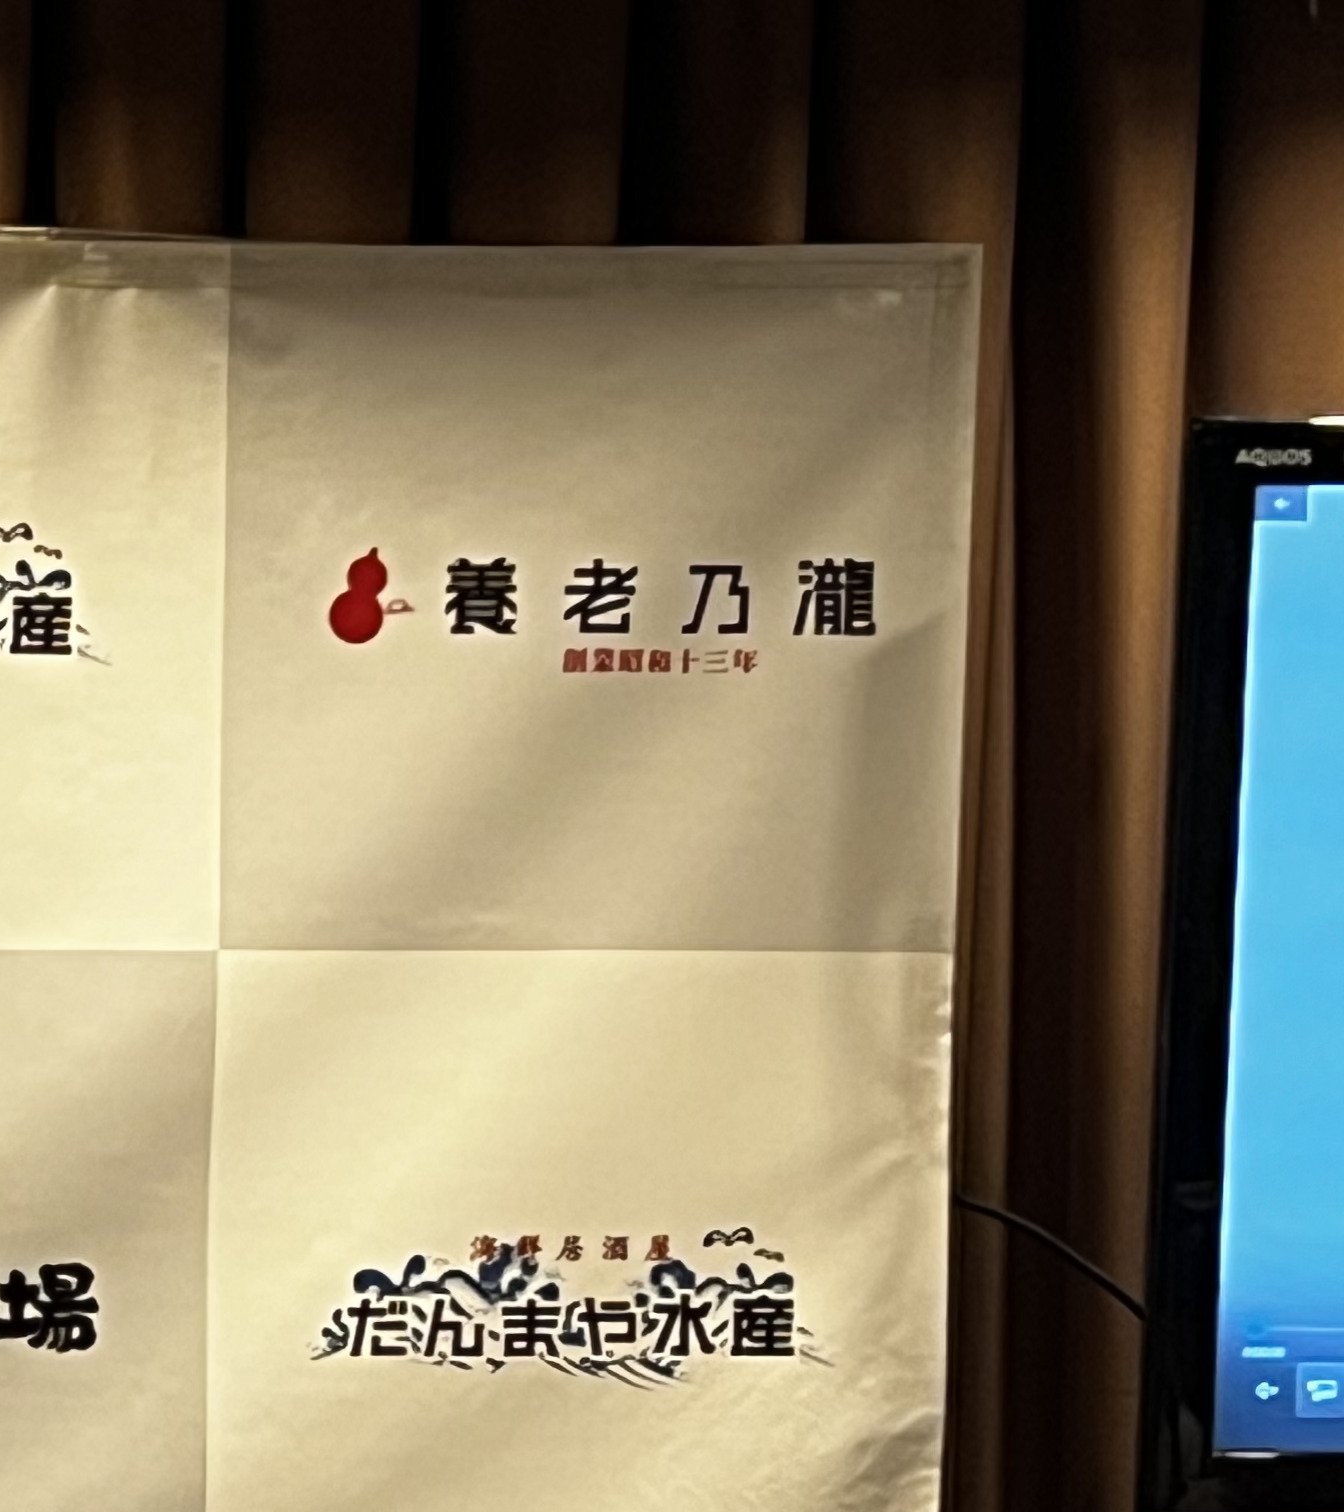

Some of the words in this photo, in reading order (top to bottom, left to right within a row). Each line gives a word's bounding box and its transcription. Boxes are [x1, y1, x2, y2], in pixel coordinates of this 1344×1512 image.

[444, 557, 877, 637] 養老乃瀧
[348, 1296, 795, 1357] だんまや水産
